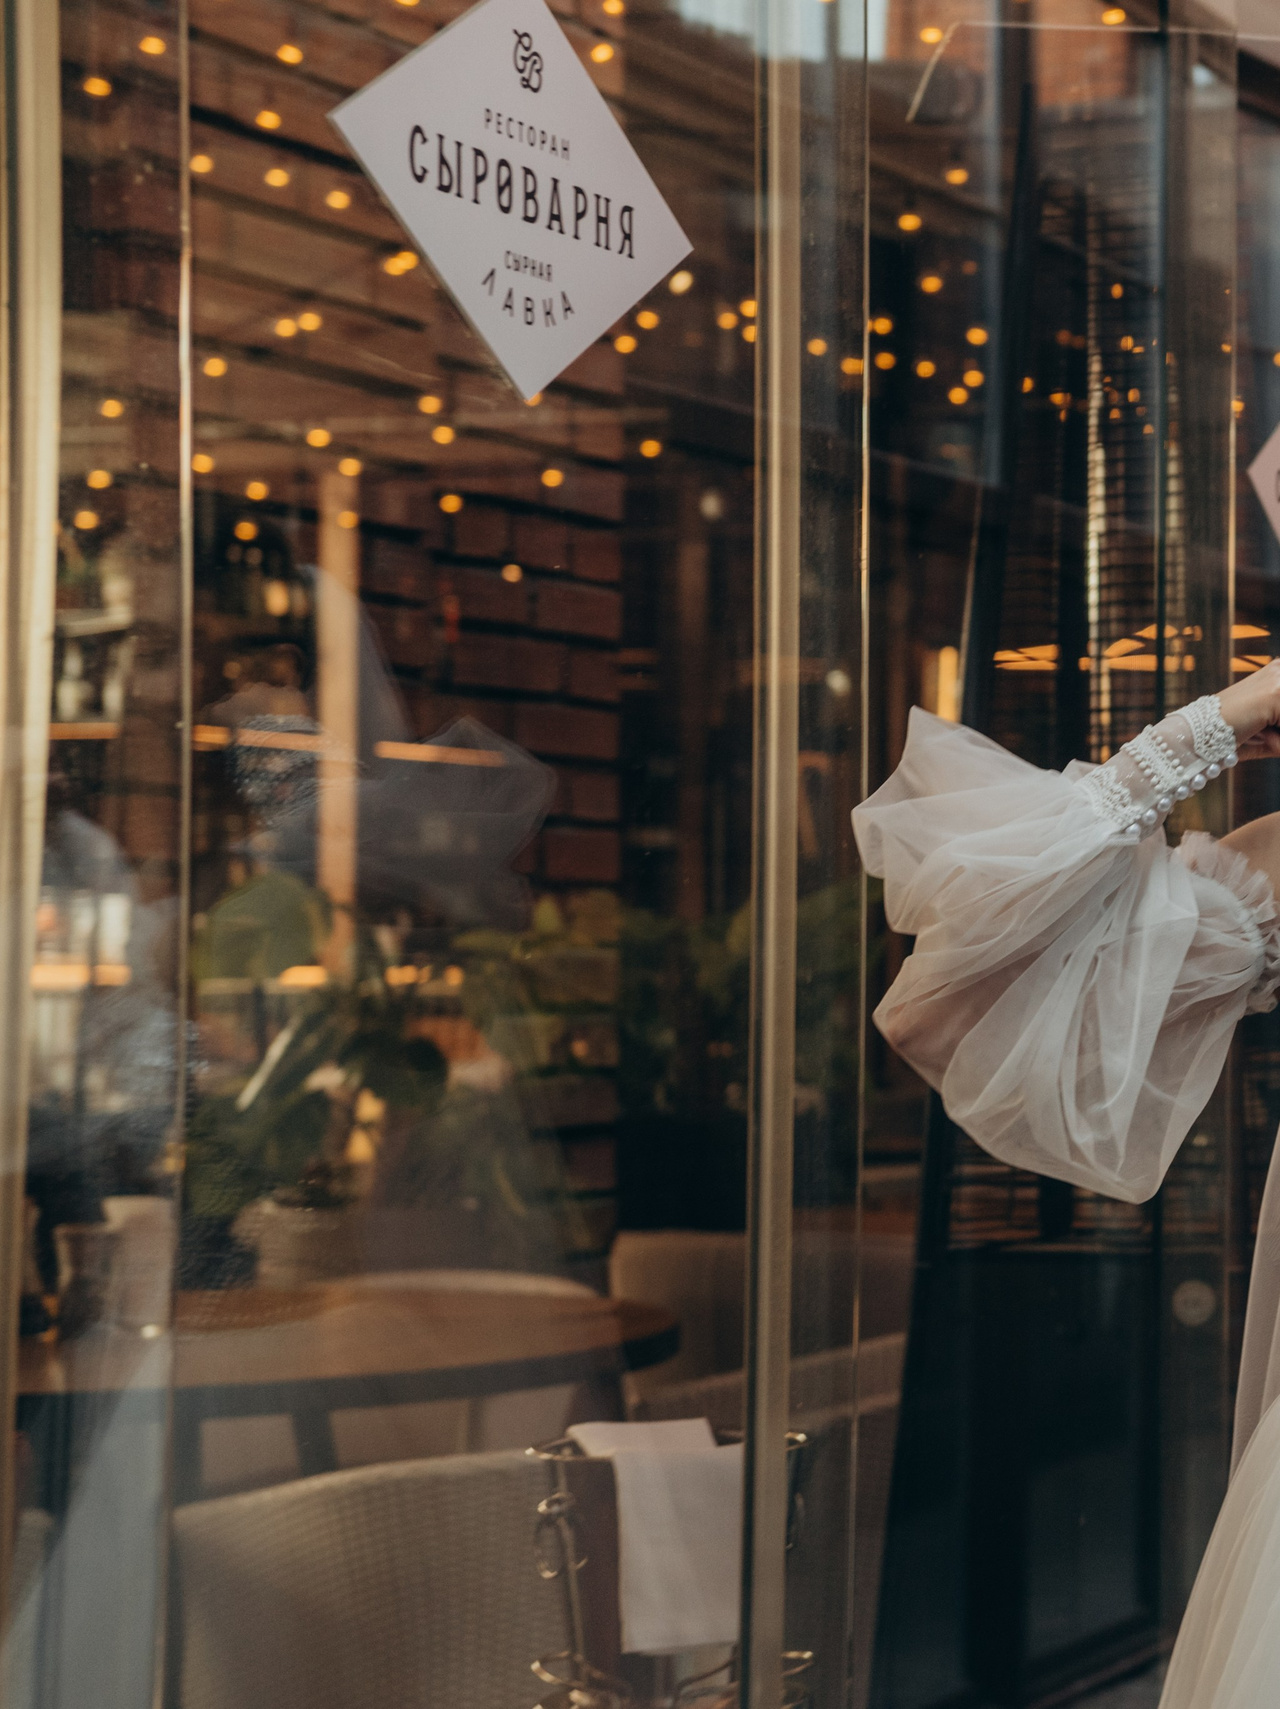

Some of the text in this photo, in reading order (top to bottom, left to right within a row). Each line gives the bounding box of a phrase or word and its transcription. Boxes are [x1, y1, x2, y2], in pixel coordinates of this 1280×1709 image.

[484, 107, 571, 161] РЕСТОРАН
[504, 250, 553, 283] СЫРНАЯ
[481, 267, 575, 328] ЛАВКА
